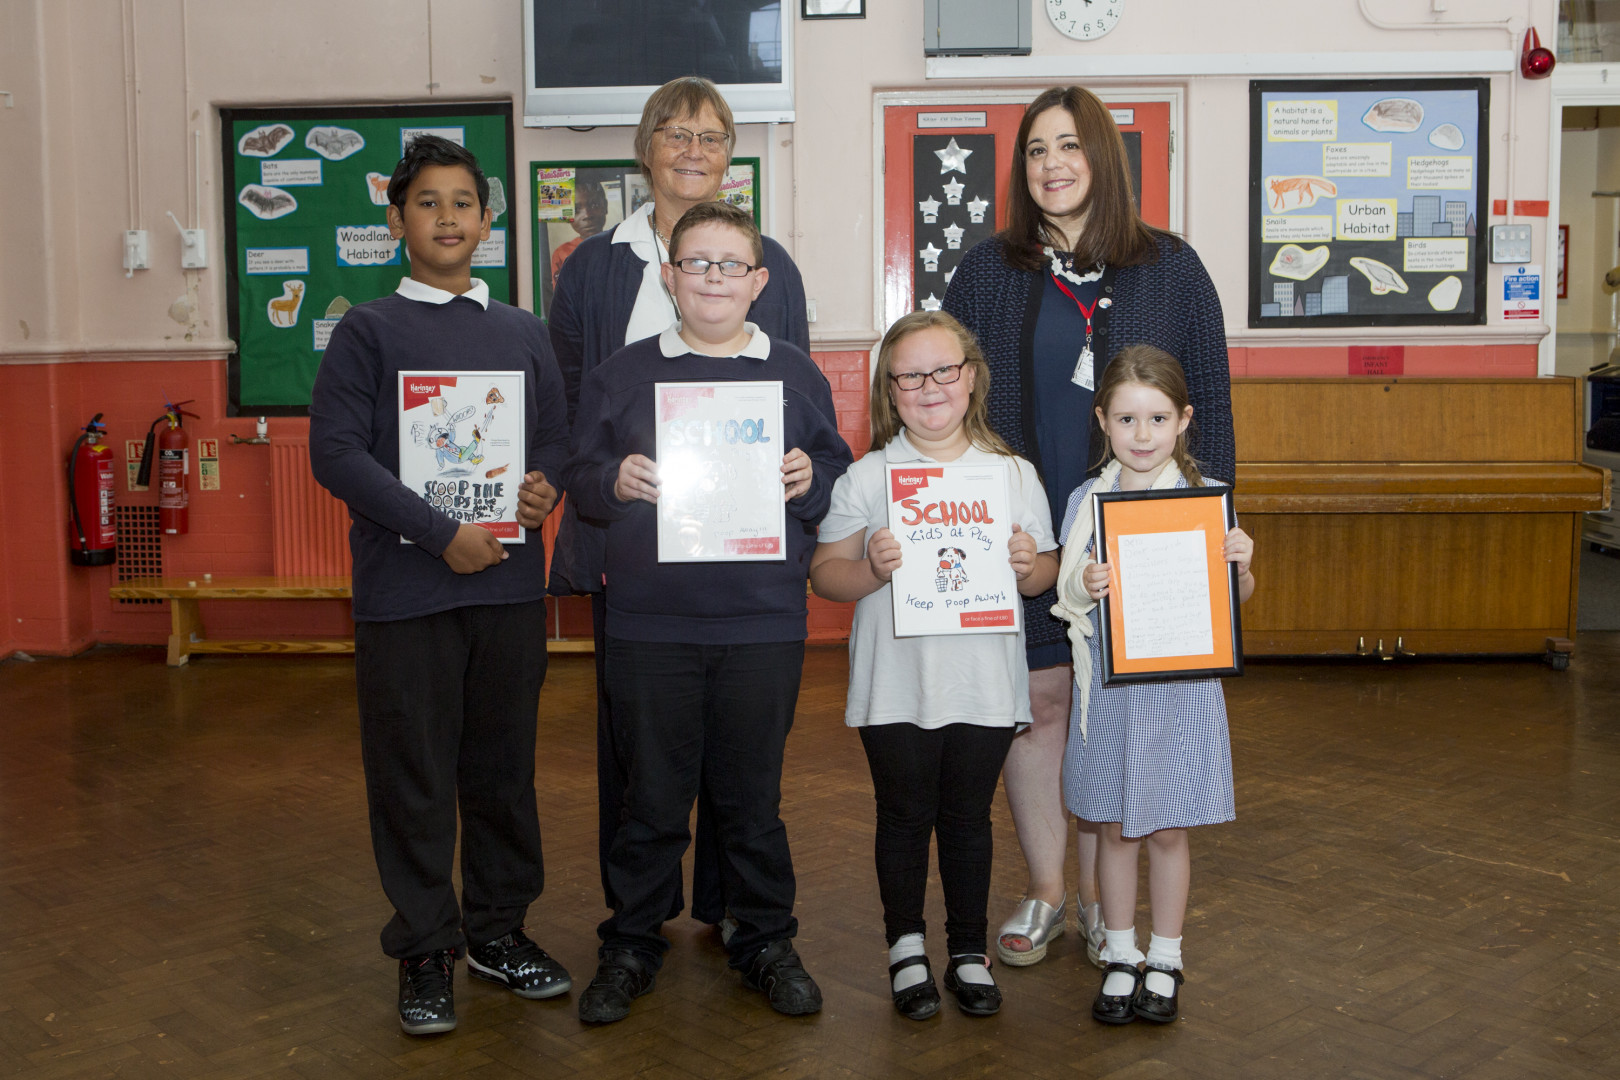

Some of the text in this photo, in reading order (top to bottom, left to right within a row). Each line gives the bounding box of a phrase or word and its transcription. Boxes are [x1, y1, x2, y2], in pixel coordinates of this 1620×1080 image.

[1060, 11, 1066, 20] 8
[1070, 20, 1076, 29] 7
[1084, 23, 1090, 32] 6
[1097, 20, 1104, 28] 5
[1348, 204, 1386, 215] Urban
[1344, 222, 1390, 234] Habitat
[346, 249, 391, 259] Habitat
[410, 384, 436, 394] Haringey
[669, 418, 770, 446] SCHOOL
[899, 476, 923, 485] Haringey
[424, 480, 504, 498] SCOOP THE
[901, 499, 994, 527] SCHOOL
[906, 527, 942, 544] Kids
[950, 528, 964, 538] at
[906, 593, 934, 610] Keep
